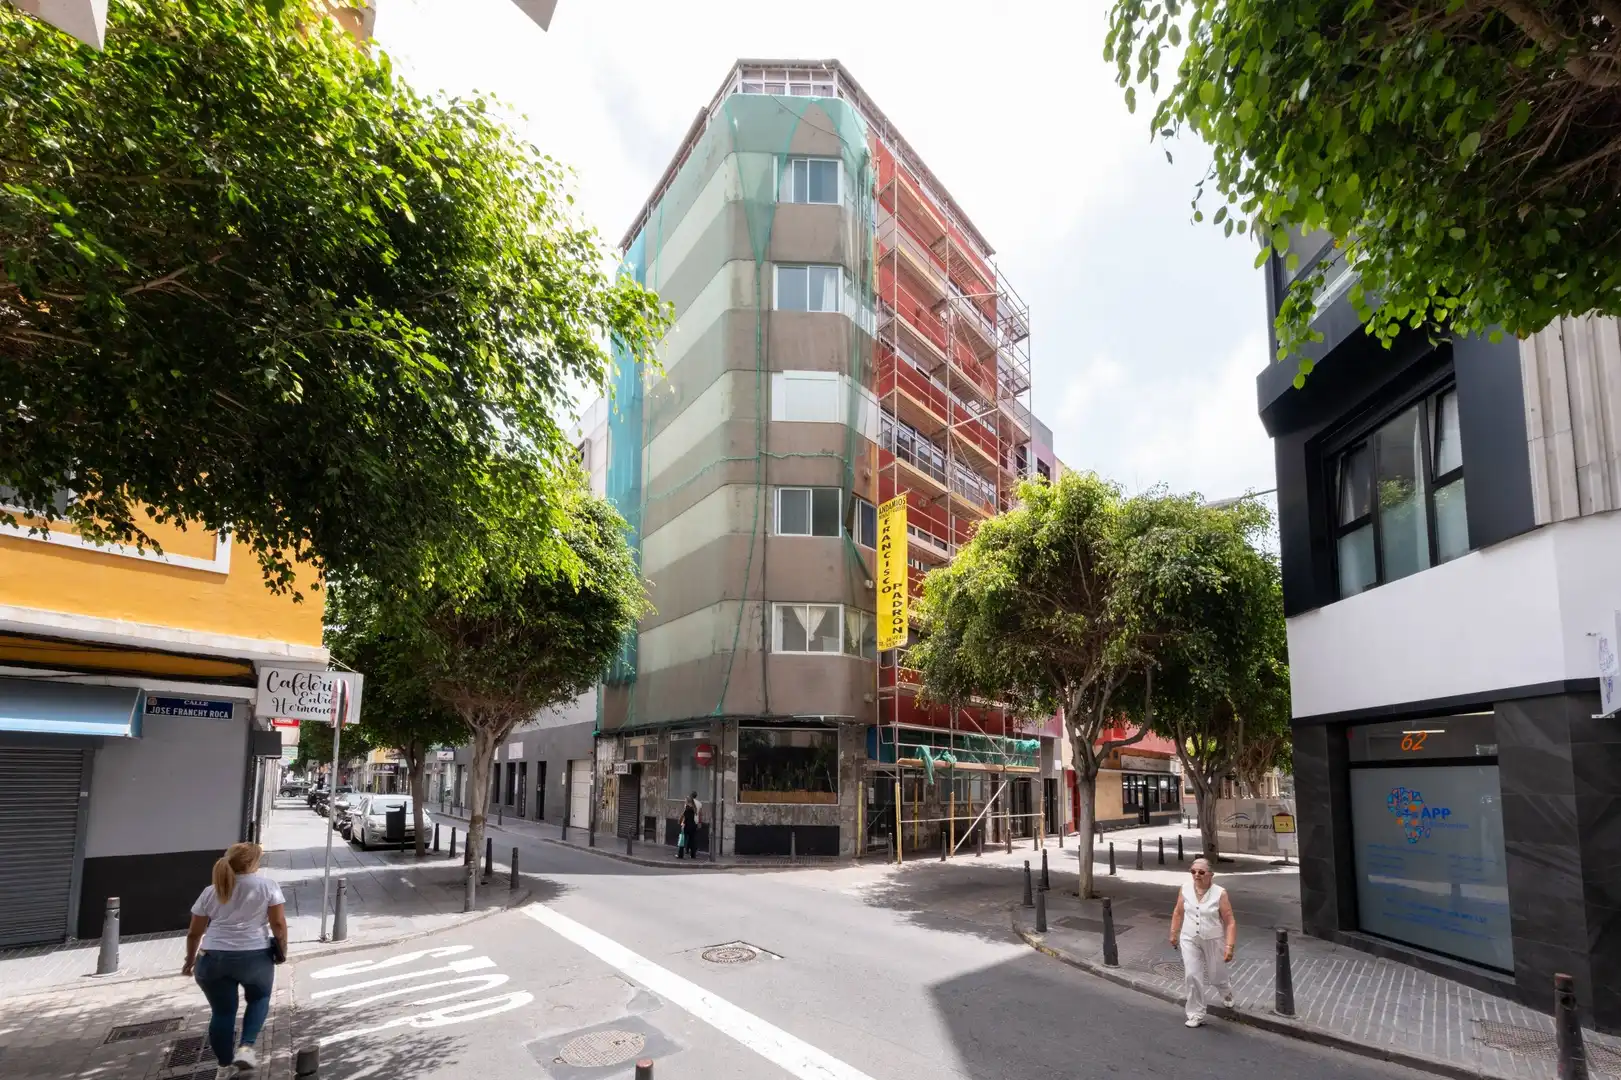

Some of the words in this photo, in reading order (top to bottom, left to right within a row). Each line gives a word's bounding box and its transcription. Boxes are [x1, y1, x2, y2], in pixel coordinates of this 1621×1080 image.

[881, 518, 892, 594] FRANCISCO
[267, 671, 332, 696] Cafeteri
[150, 706, 171, 714] JOSE
[173, 708, 208, 717] FRANCHY
[209, 711, 229, 719] ROCA
[1401, 731, 1428, 750] 62
[1421, 807, 1451, 819] APP
